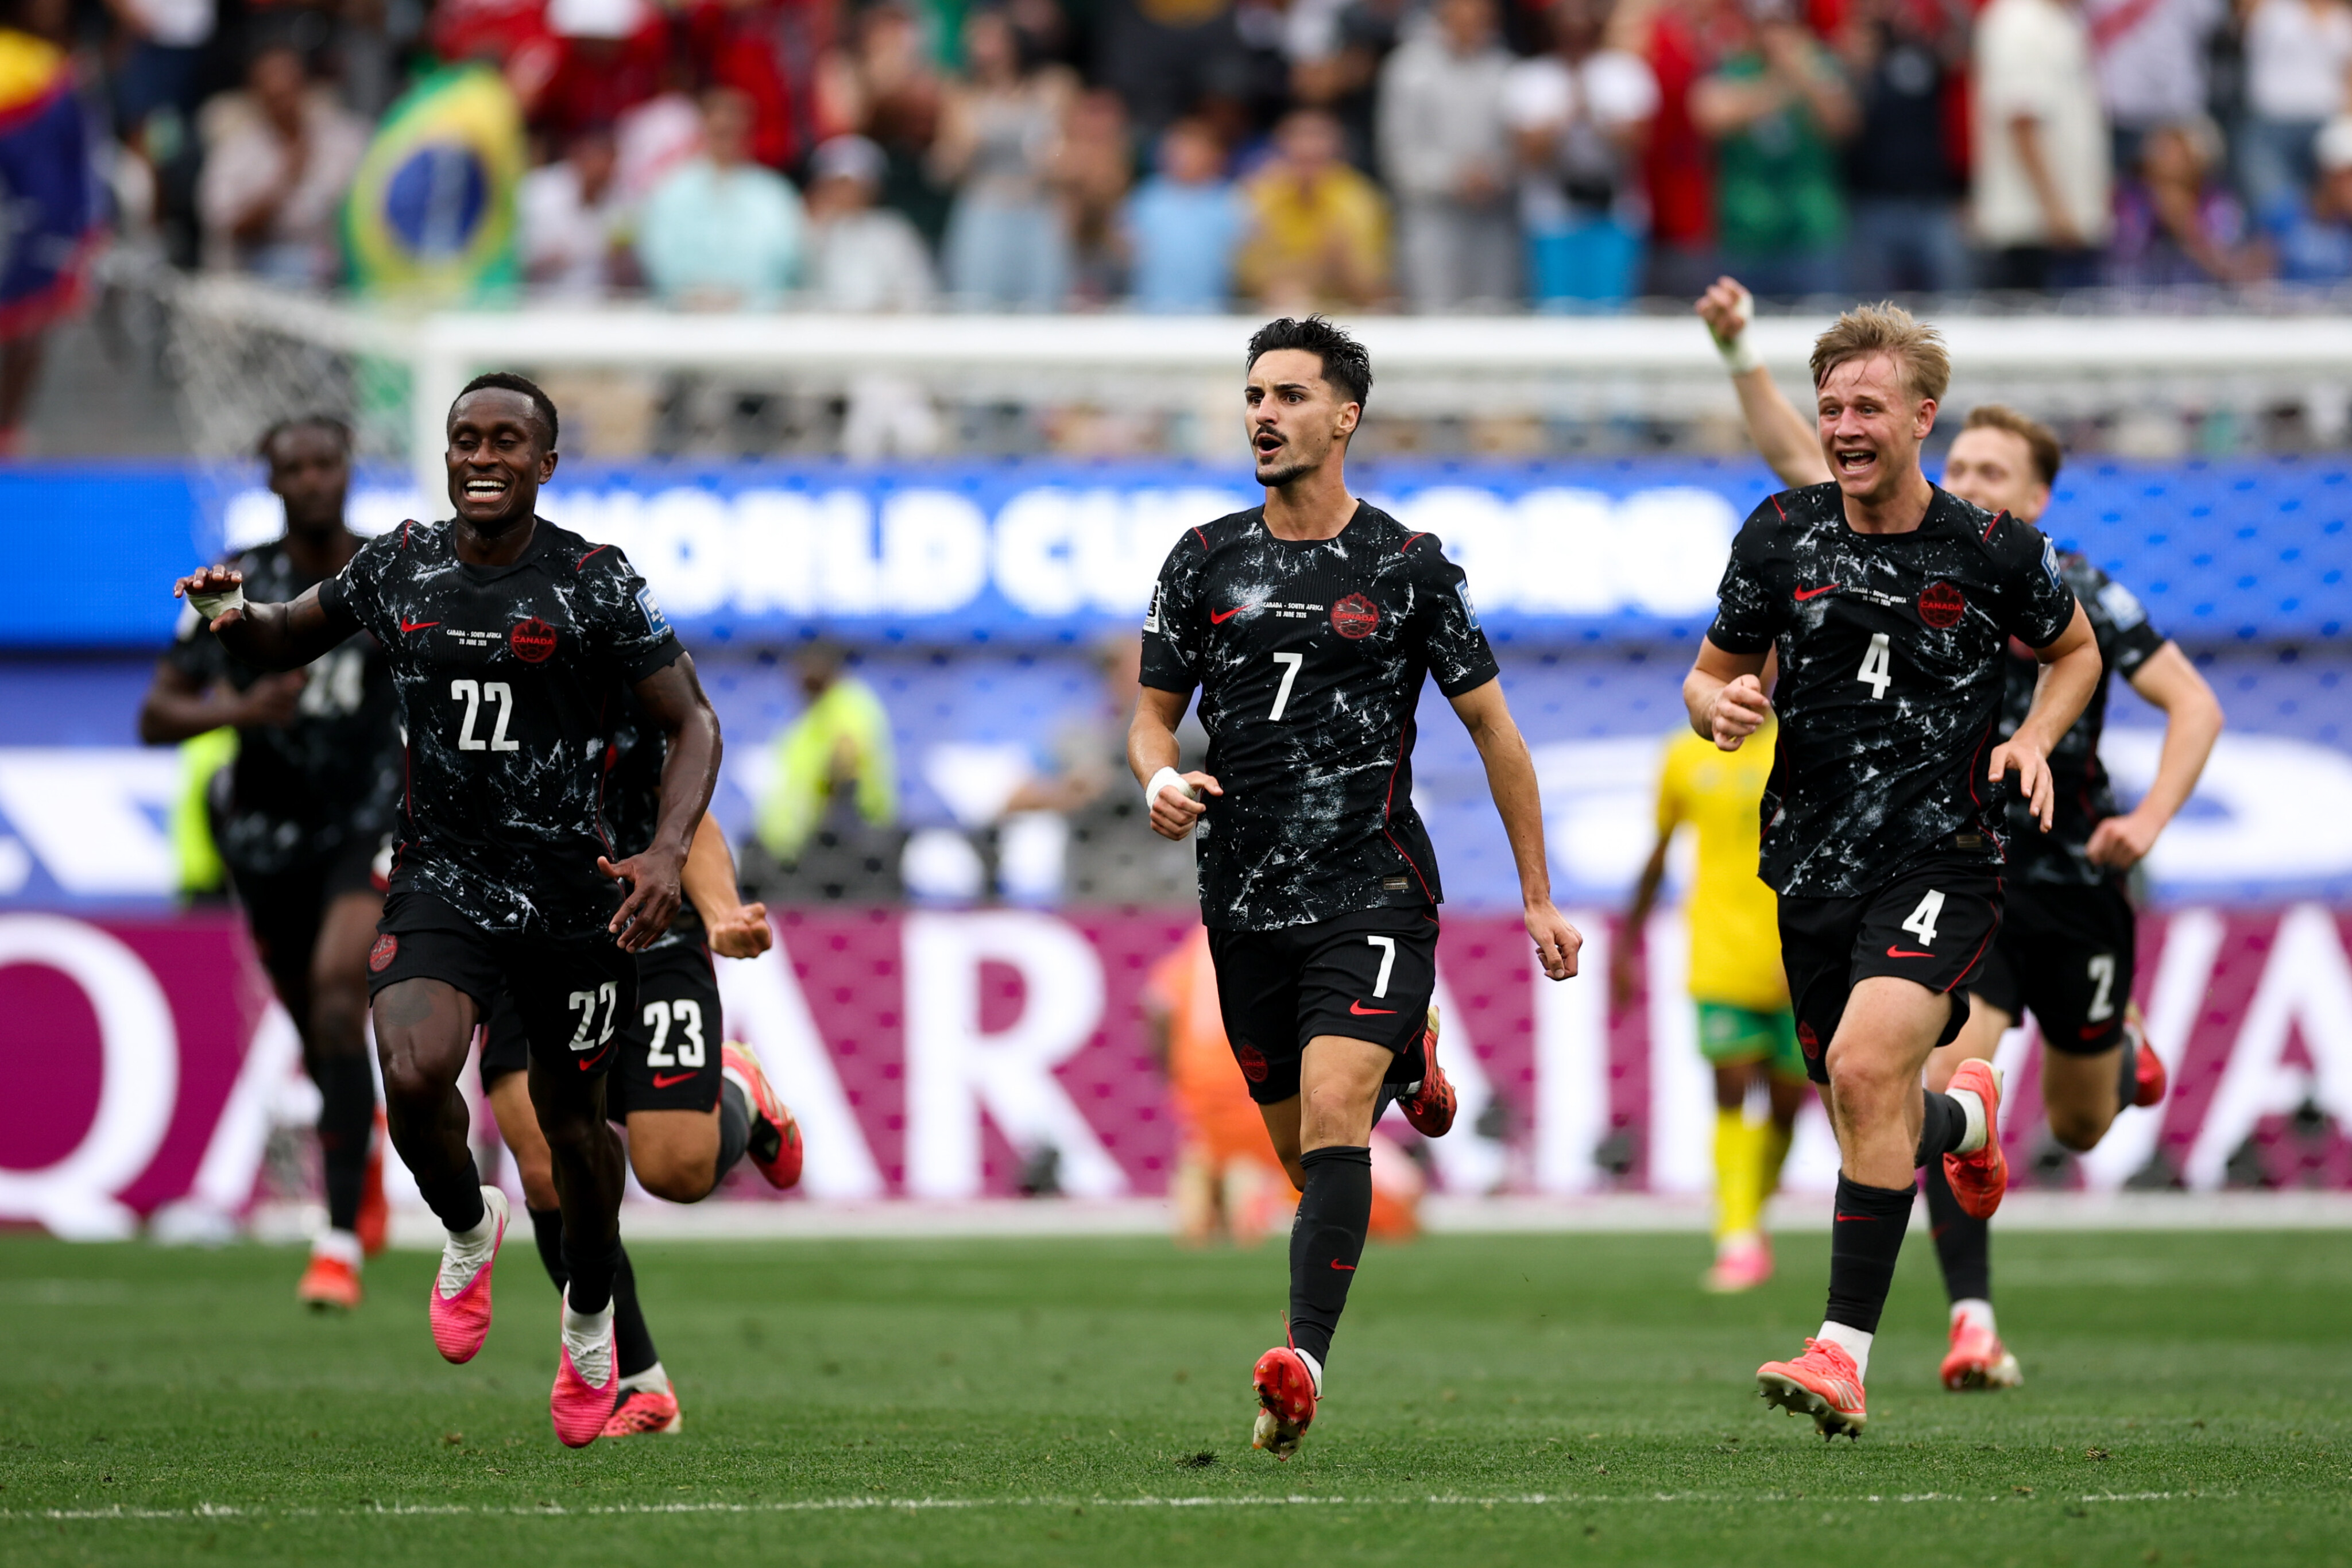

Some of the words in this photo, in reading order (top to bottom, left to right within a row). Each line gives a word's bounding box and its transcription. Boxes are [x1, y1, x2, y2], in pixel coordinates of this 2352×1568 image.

[992, 485, 1260, 620] CU
[1333, 612, 1375, 622] CANADA
[1849, 586, 1868, 594] CANADA
[1890, 595, 1907, 603] AFRICA
[1921, 601, 1961, 610] CANADA
[446, 629, 466, 637] CANADA
[512, 636, 553, 645] CANADA
[1268, 652, 1303, 721] 7
[1856, 633, 1891, 700] 4
[451, 679, 519, 751] 22
[1901, 889, 1945, 946] 4
[1367, 935, 1396, 998] 7
[2088, 954, 2115, 1022] 2
[568, 981, 618, 1051] 22
[643, 999, 706, 1068] 23
